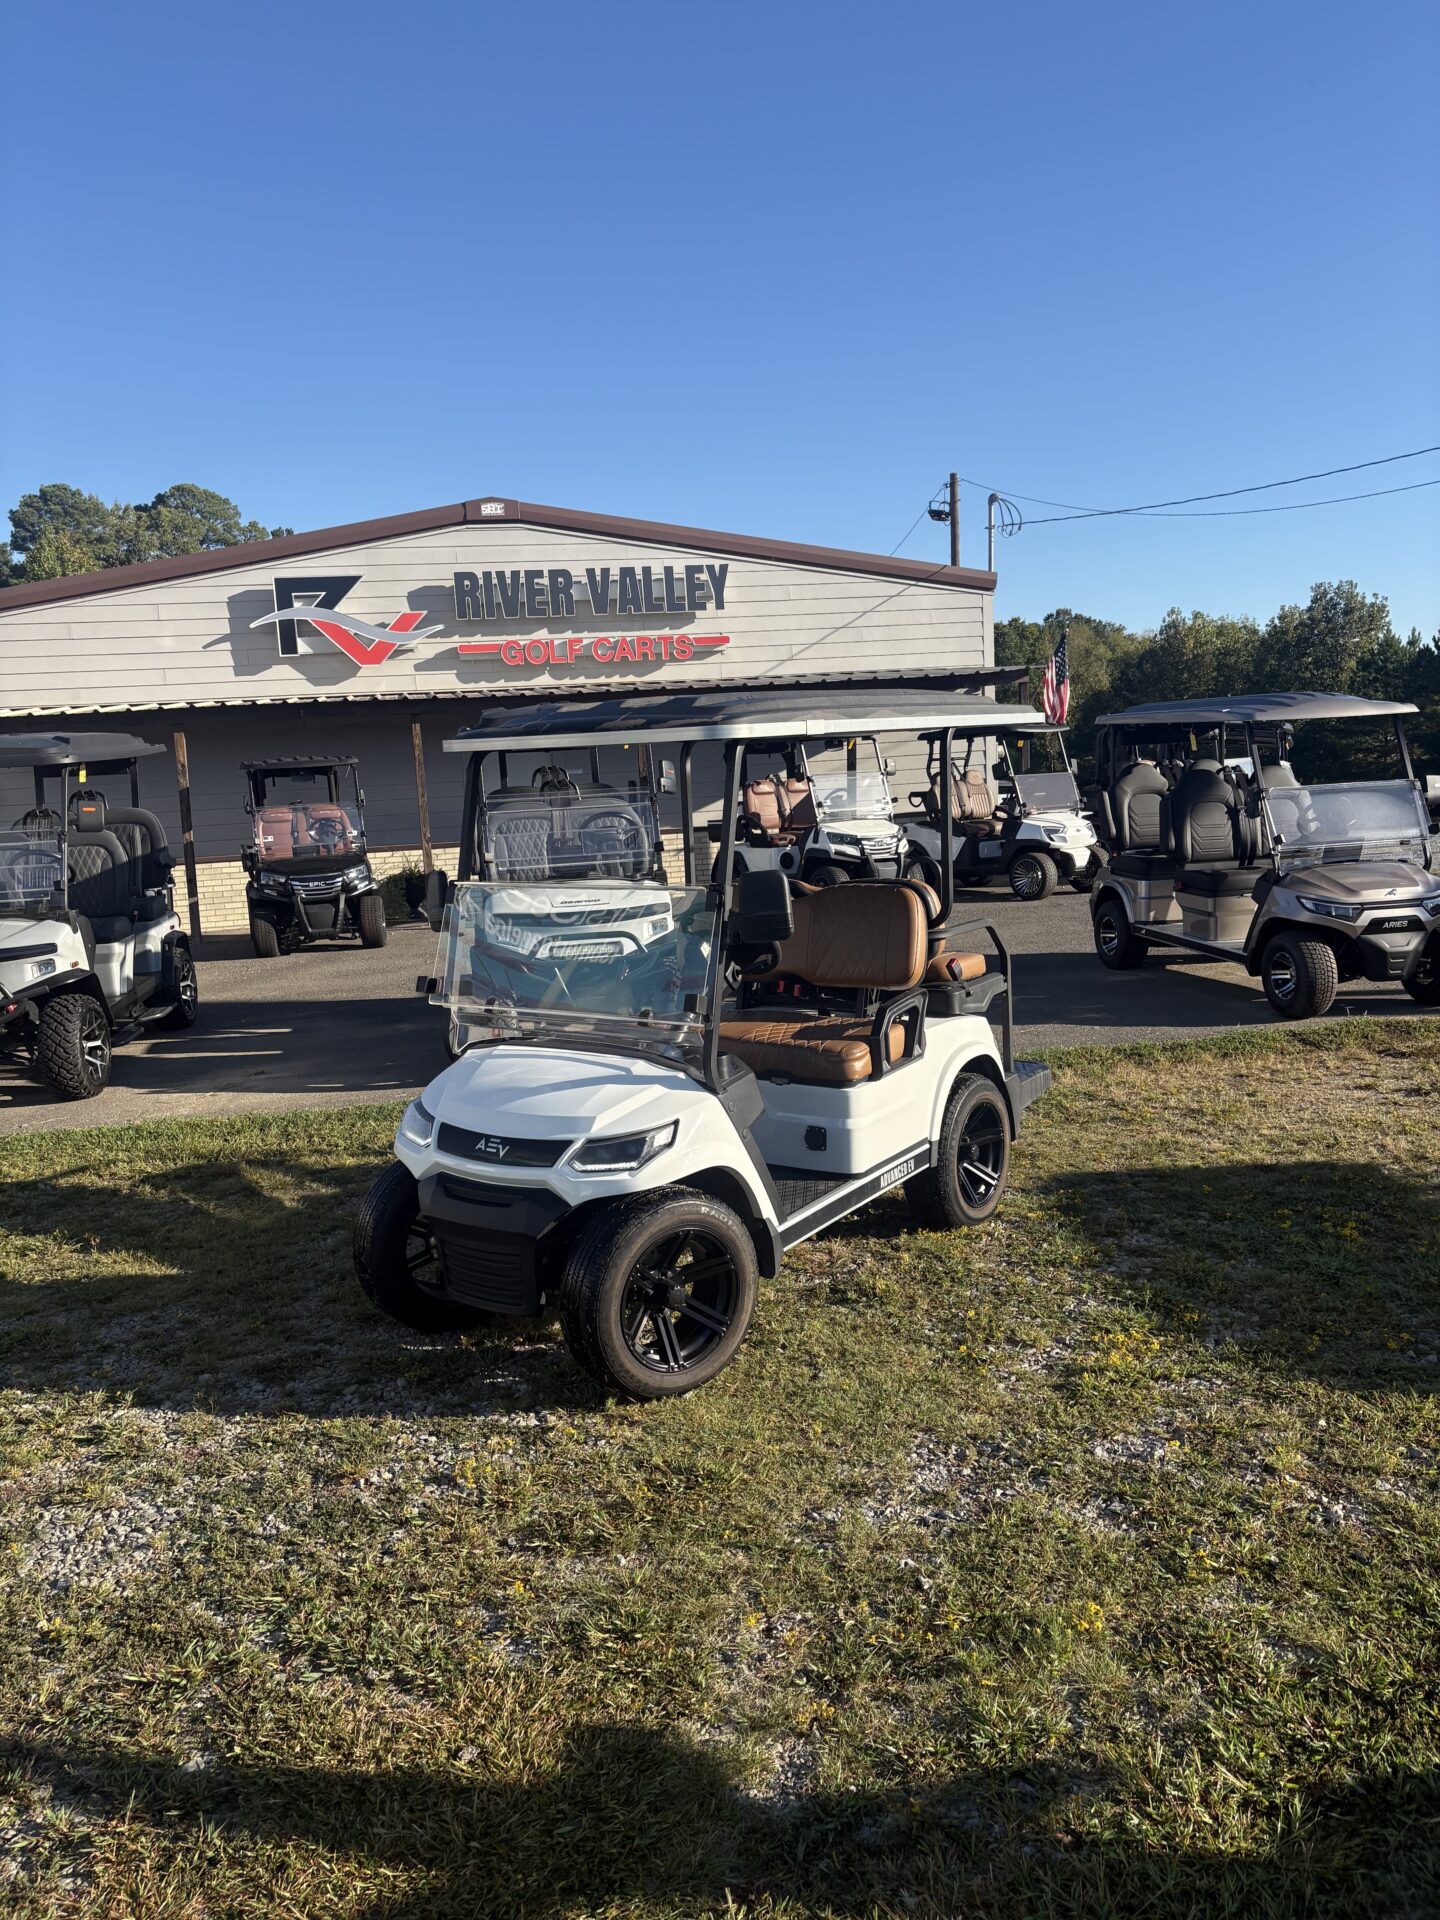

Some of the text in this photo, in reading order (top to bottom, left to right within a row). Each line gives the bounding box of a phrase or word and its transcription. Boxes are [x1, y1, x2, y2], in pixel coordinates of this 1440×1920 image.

[453, 563, 729, 620] RIVER VALLEY
[500, 634, 694, 665] GOLF CARTS
[1382, 920, 1409, 929] ARIES
[475, 1136, 510, 1159] AEV
